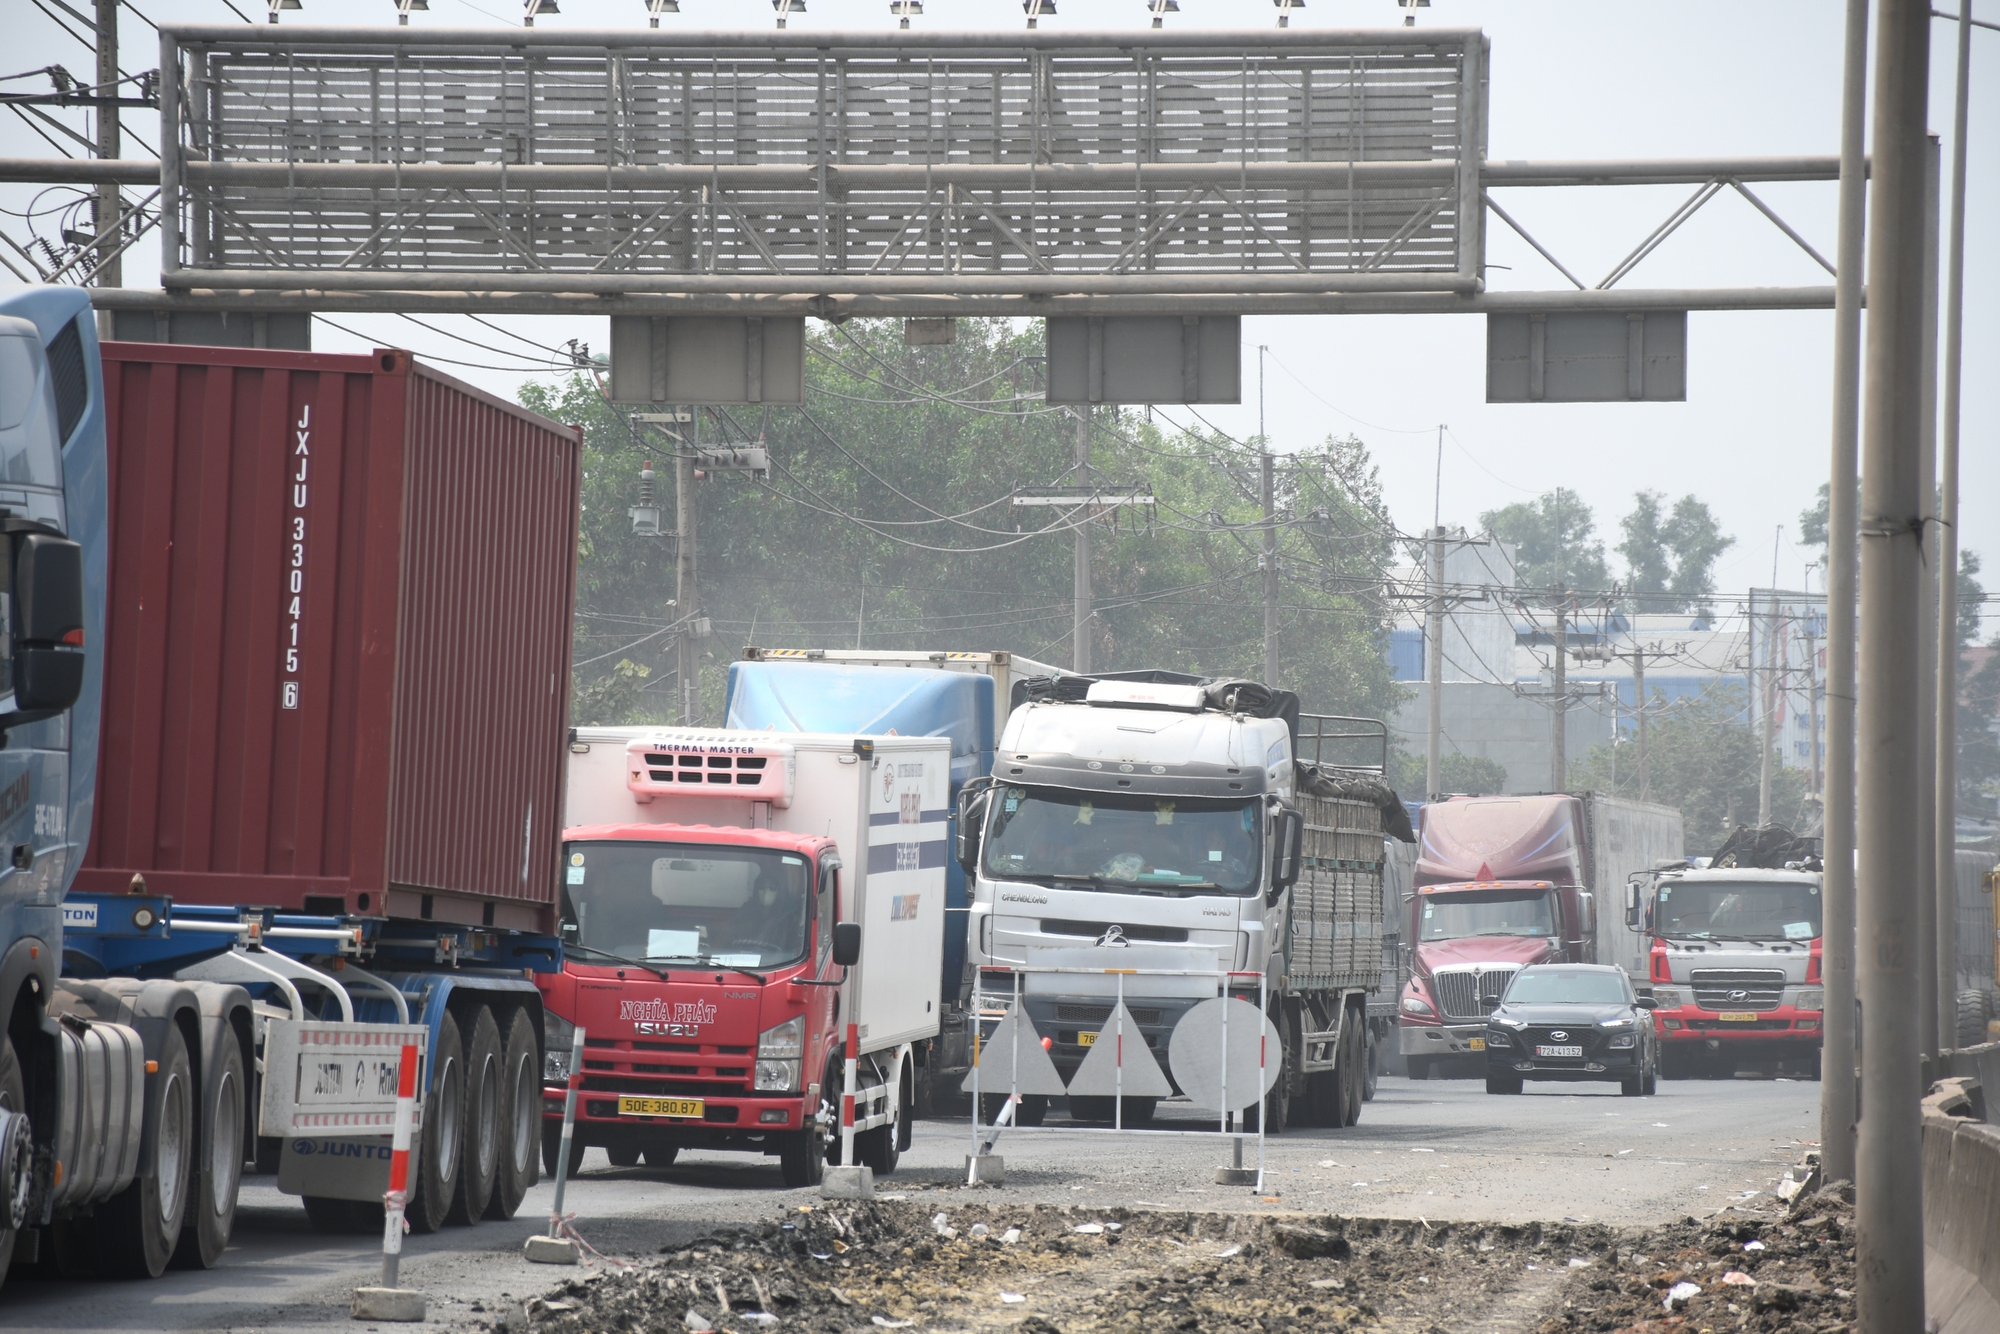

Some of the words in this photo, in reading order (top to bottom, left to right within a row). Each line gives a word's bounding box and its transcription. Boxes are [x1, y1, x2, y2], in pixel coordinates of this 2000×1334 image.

[293, 404, 310, 509] JXJU
[285, 516, 305, 673] 330415
[282, 682, 299, 709] 6
[653, 743, 705, 753] THERMAL
[709, 745, 754, 754] MASTER
[63, 909, 95, 921] TON
[724, 991, 757, 1000] NMR
[620, 997, 671, 1023] NGHĨA
[674, 998, 718, 1024] PHÁT
[633, 1022, 699, 1038] ISUZU
[1083, 1034, 1099, 1044] 78
[1541, 1047, 1581, 1056] 72A-413.52
[625, 1099, 697, 1115] 50E-380.87
[317, 1141, 393, 1160] JUNTO
